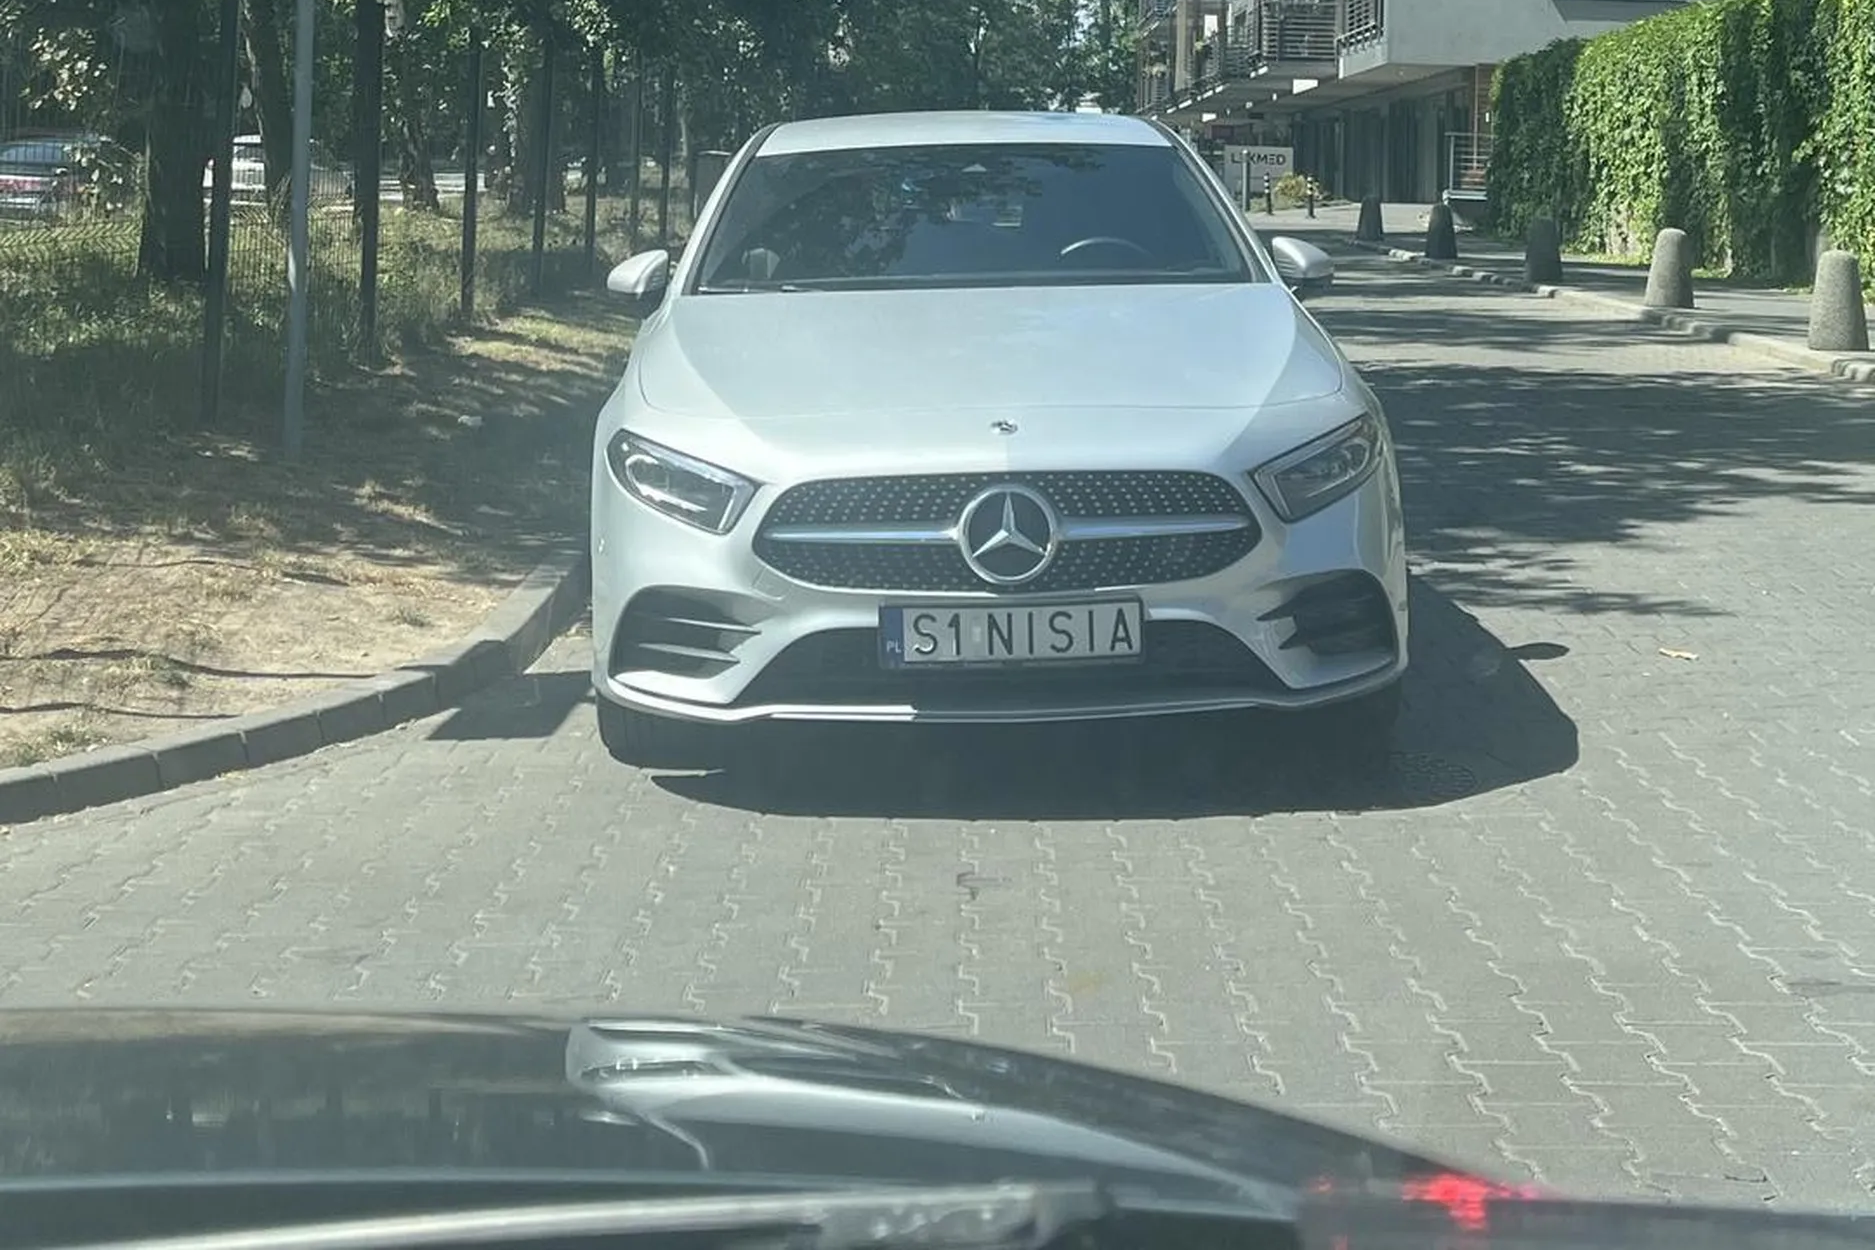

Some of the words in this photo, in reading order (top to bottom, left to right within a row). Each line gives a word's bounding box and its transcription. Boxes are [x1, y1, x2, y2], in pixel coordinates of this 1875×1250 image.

[1231, 152, 1287, 165] LXMED
[912, 613, 961, 656] S1
[987, 607, 1134, 655] NISIA
[886, 640, 902, 653] PL
